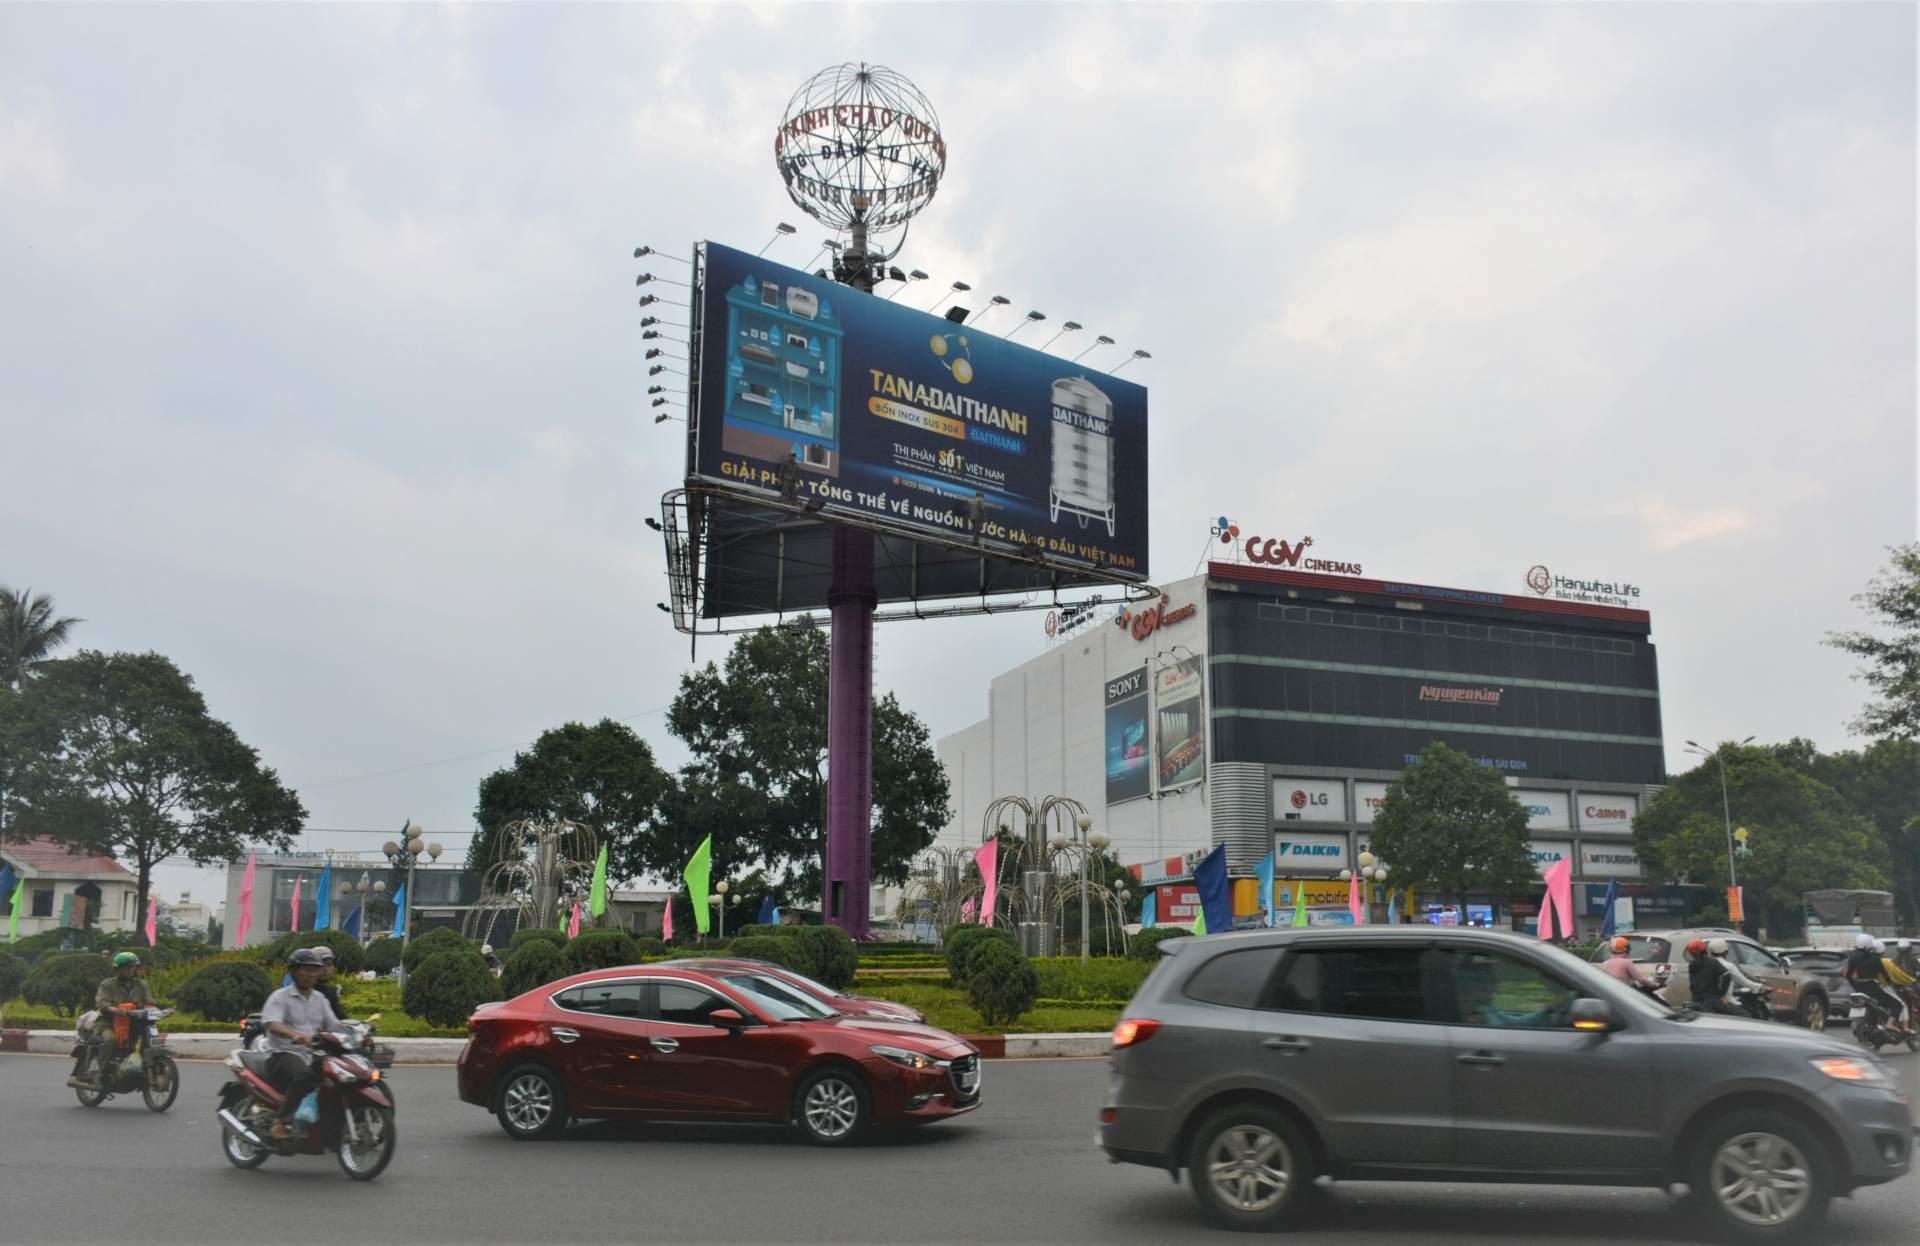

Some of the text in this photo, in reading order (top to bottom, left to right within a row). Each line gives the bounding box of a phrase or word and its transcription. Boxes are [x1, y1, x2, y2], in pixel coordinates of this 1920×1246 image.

[837, 102, 892, 128] CHÀO
[898, 410, 921, 424] INOX
[923, 417, 940, 429] SUS
[942, 422, 959, 434] 304
[894, 443, 909, 458] THỊ
[911, 448, 936, 464] PHẦN
[965, 462, 983, 477] VIỆT
[985, 469, 1005, 482] NAM
[918, 483, 935, 494] 6086
[720, 461, 756, 480] GIẢI
[808, 478, 852, 502] TỔNG
[857, 492, 886, 510] THỂ
[890, 498, 909, 515] VỀ
[914, 505, 964, 528] NGUỒN
[1049, 537, 1076, 555] ĐẦU
[1079, 545, 1106, 562] VIỆT
[1109, 553, 1135, 568] NAM
[1245, 536, 1362, 576] CGV CINEMAS
[1422, 587, 1467, 601] SHOPPING
[1468, 592, 1504, 604] CENTER
[1555, 575, 1640, 598] Hanwha Life
[1131, 602, 1195, 640] CGV CINEMAS
[1108, 673, 1142, 699] SONY
[1310, 793, 1328, 806] LG
[1529, 805, 1551, 816] QUA
[1585, 806, 1626, 820] Canon
[336, 852, 360, 860] VNVC
[1292, 845, 1340, 857] DAIKIN
